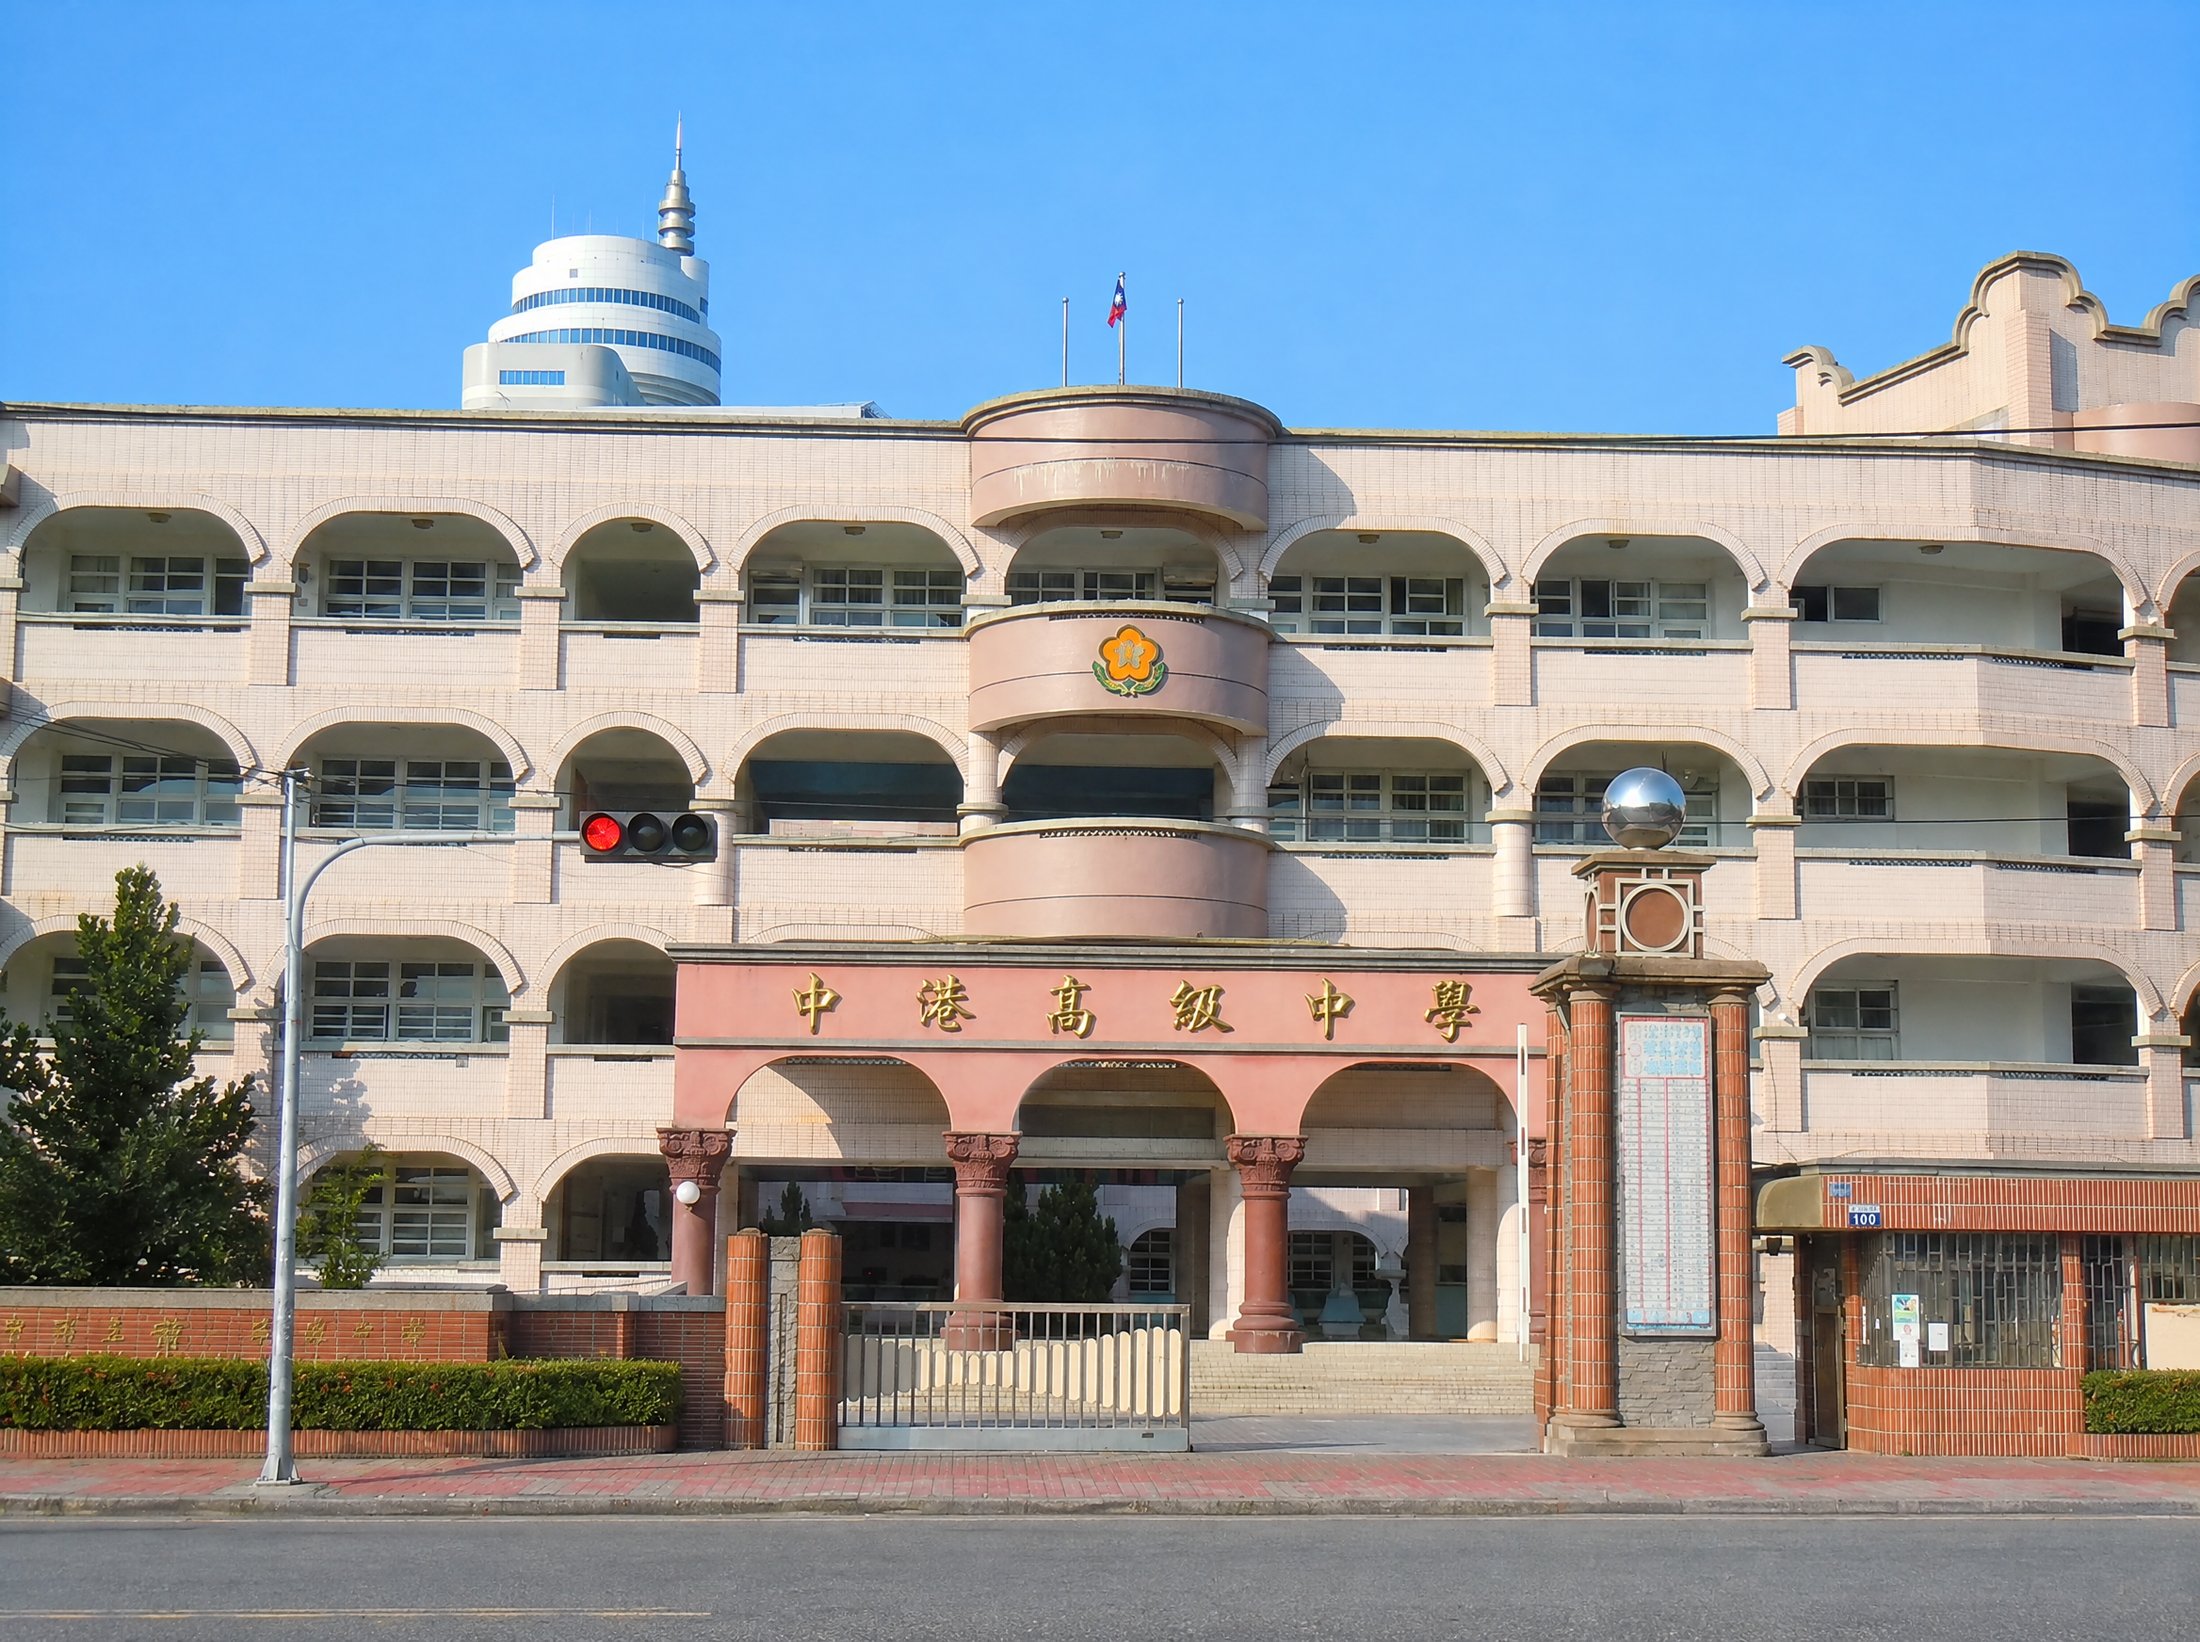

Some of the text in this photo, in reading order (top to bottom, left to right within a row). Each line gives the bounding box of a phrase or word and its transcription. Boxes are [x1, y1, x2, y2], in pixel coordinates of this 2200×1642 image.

[791, 971, 1480, 1043] 中港高級中學
[1853, 1213, 1876, 1226] 100
